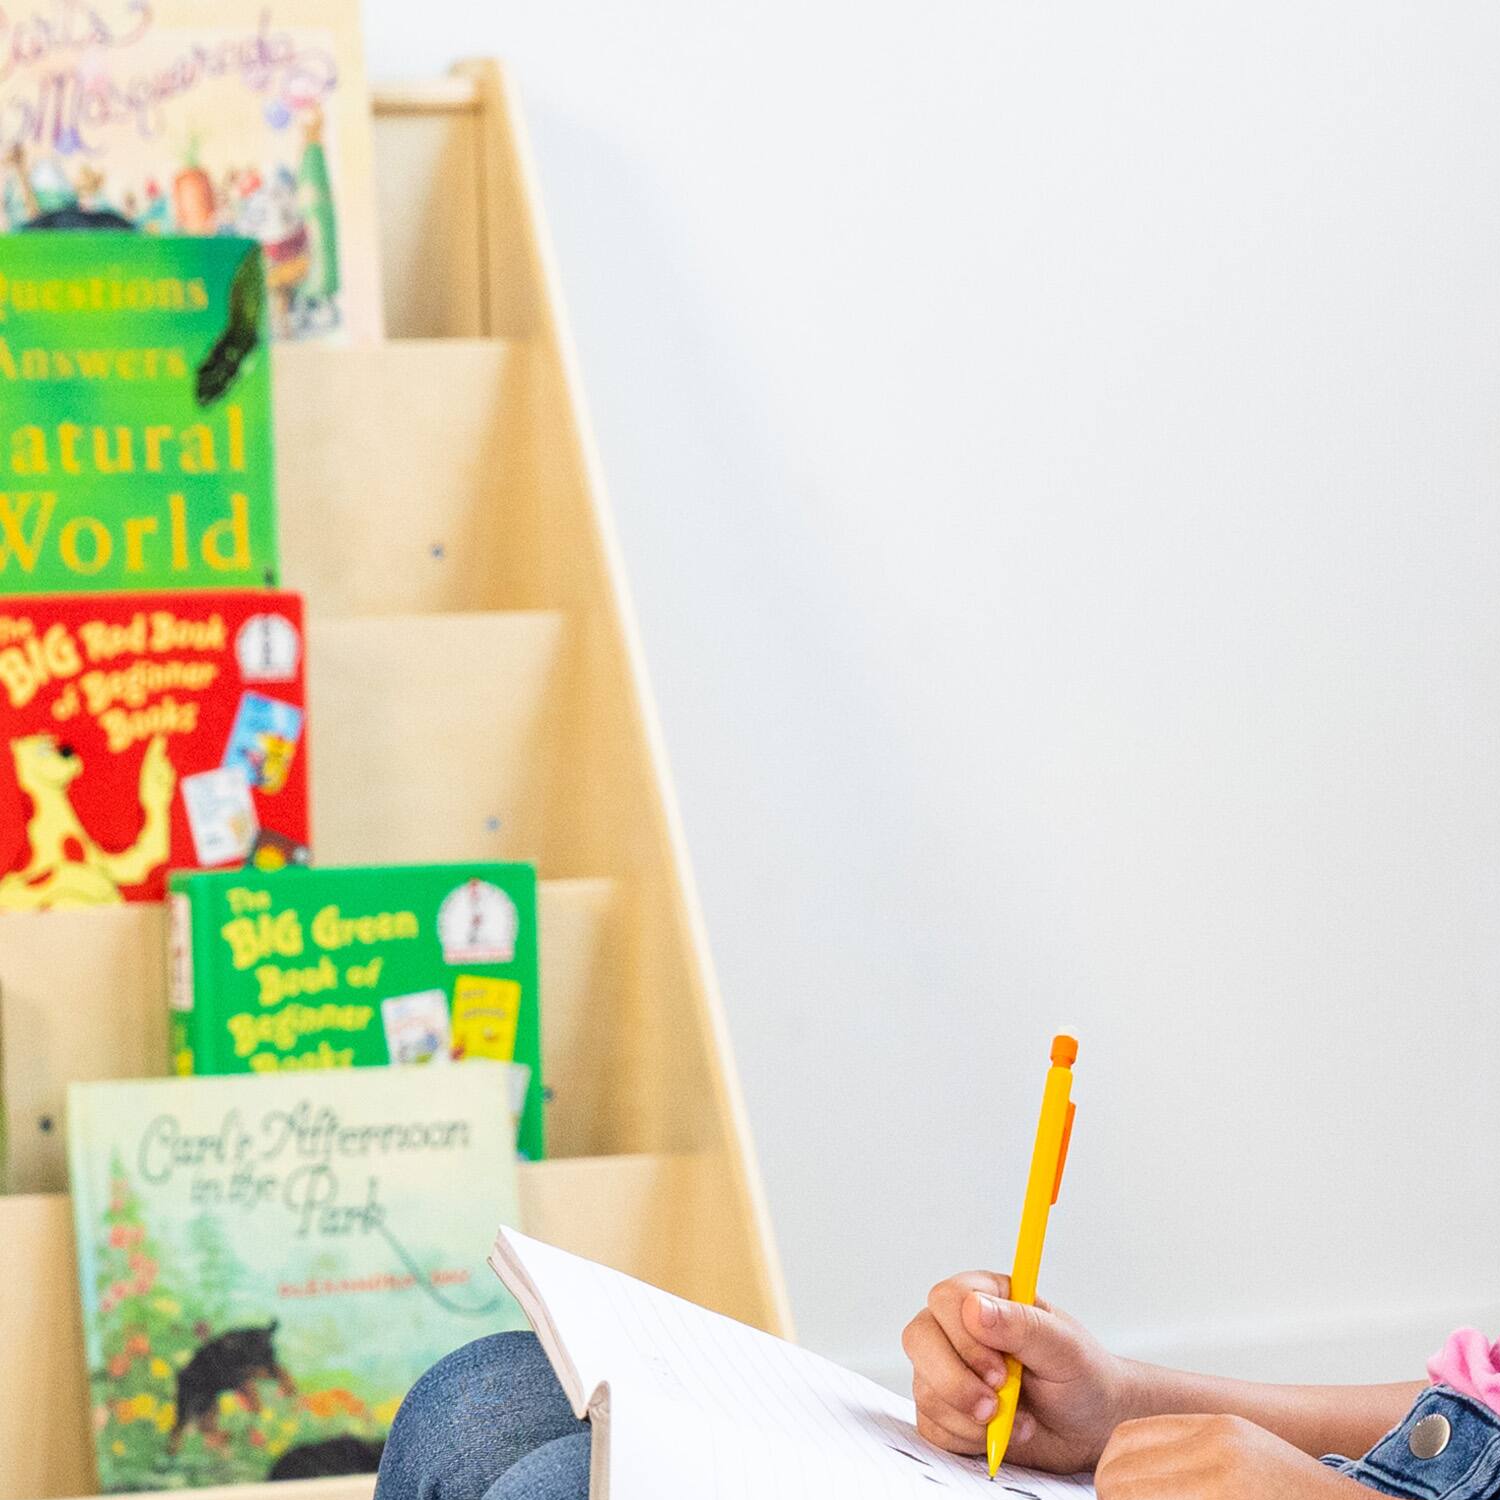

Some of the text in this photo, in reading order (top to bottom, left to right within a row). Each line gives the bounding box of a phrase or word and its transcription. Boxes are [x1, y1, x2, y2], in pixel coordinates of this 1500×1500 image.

[0, 270, 209, 322] uestions
[10, 404, 246, 473] atural
[0, 492, 251, 574] World
[0, 610, 227, 709] BIG Red Book
[51, 659, 219, 721] of Beginner
[98, 695, 200, 753] Books
[226, 886, 272, 915] The
[221, 904, 419, 970] BIG Green
[254, 954, 384, 1008] Book of
[226, 1003, 374, 1058] Beginner
[137, 1097, 471, 1186] Carl's Afternoon
[190, 1160, 388, 1240] in the Park
